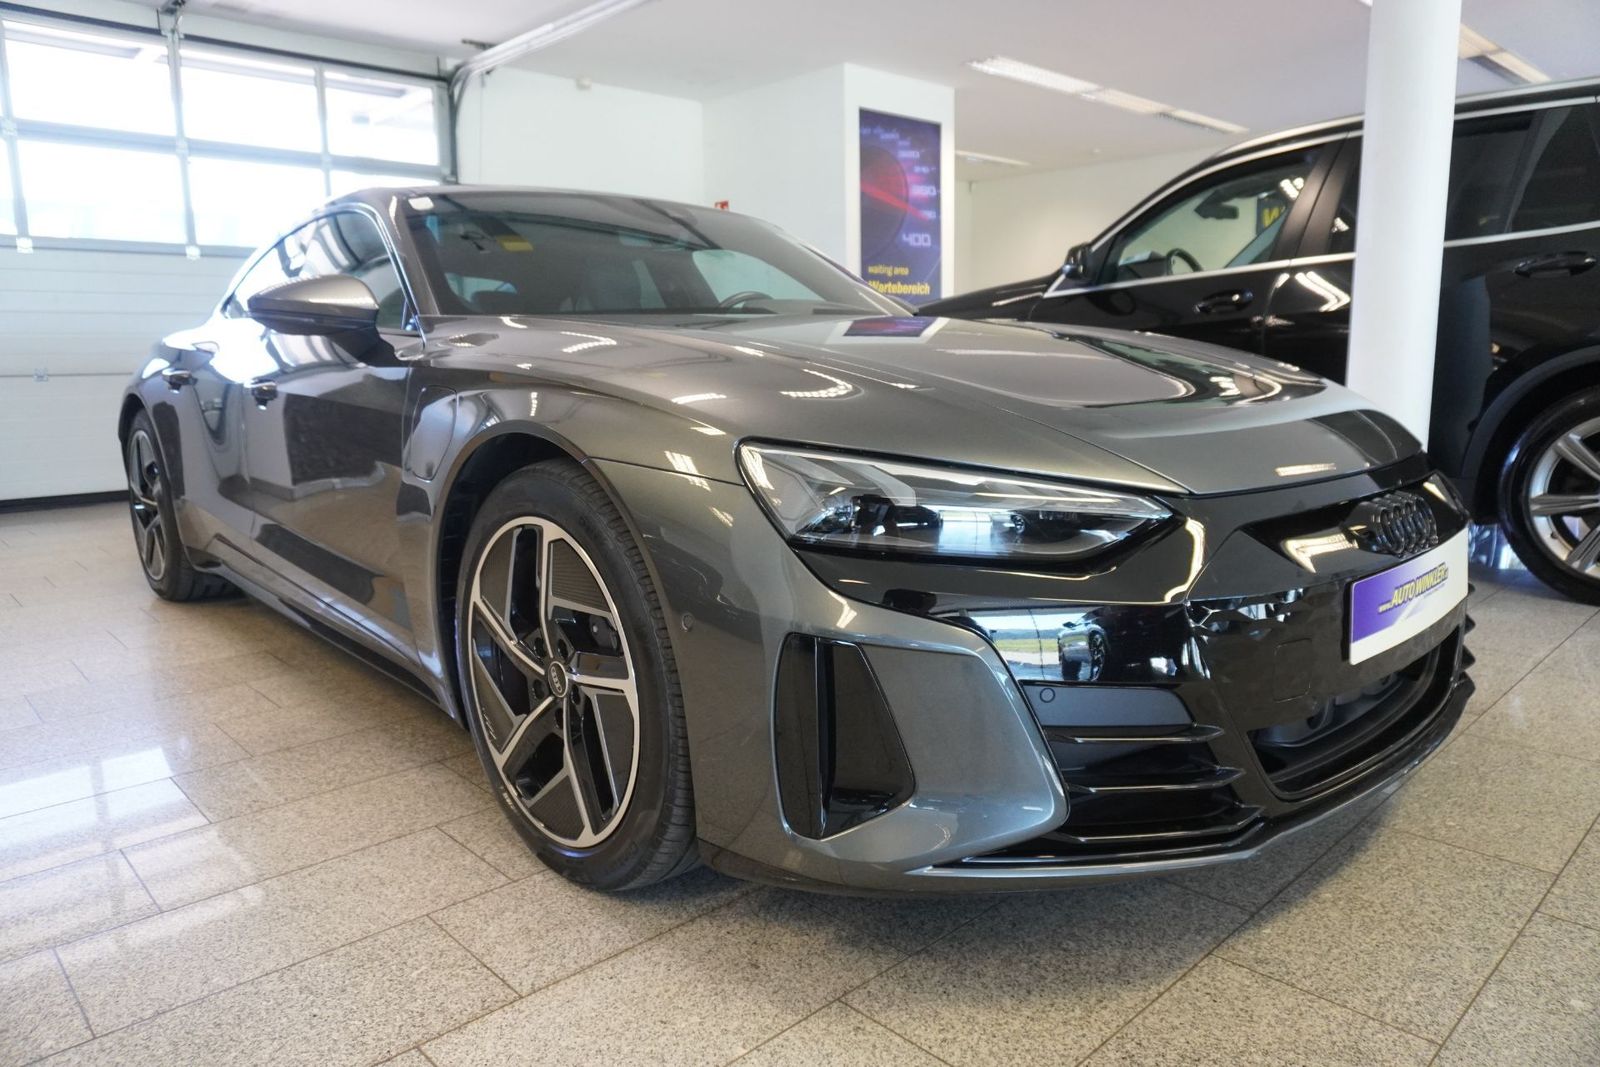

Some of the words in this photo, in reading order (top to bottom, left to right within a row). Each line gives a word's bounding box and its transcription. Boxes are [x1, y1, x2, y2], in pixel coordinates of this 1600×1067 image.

[902, 233, 931, 247] 400
[868, 265, 893, 277] waiting
[893, 266, 909, 276] area
[1391, 579, 1416, 607] AUTO
